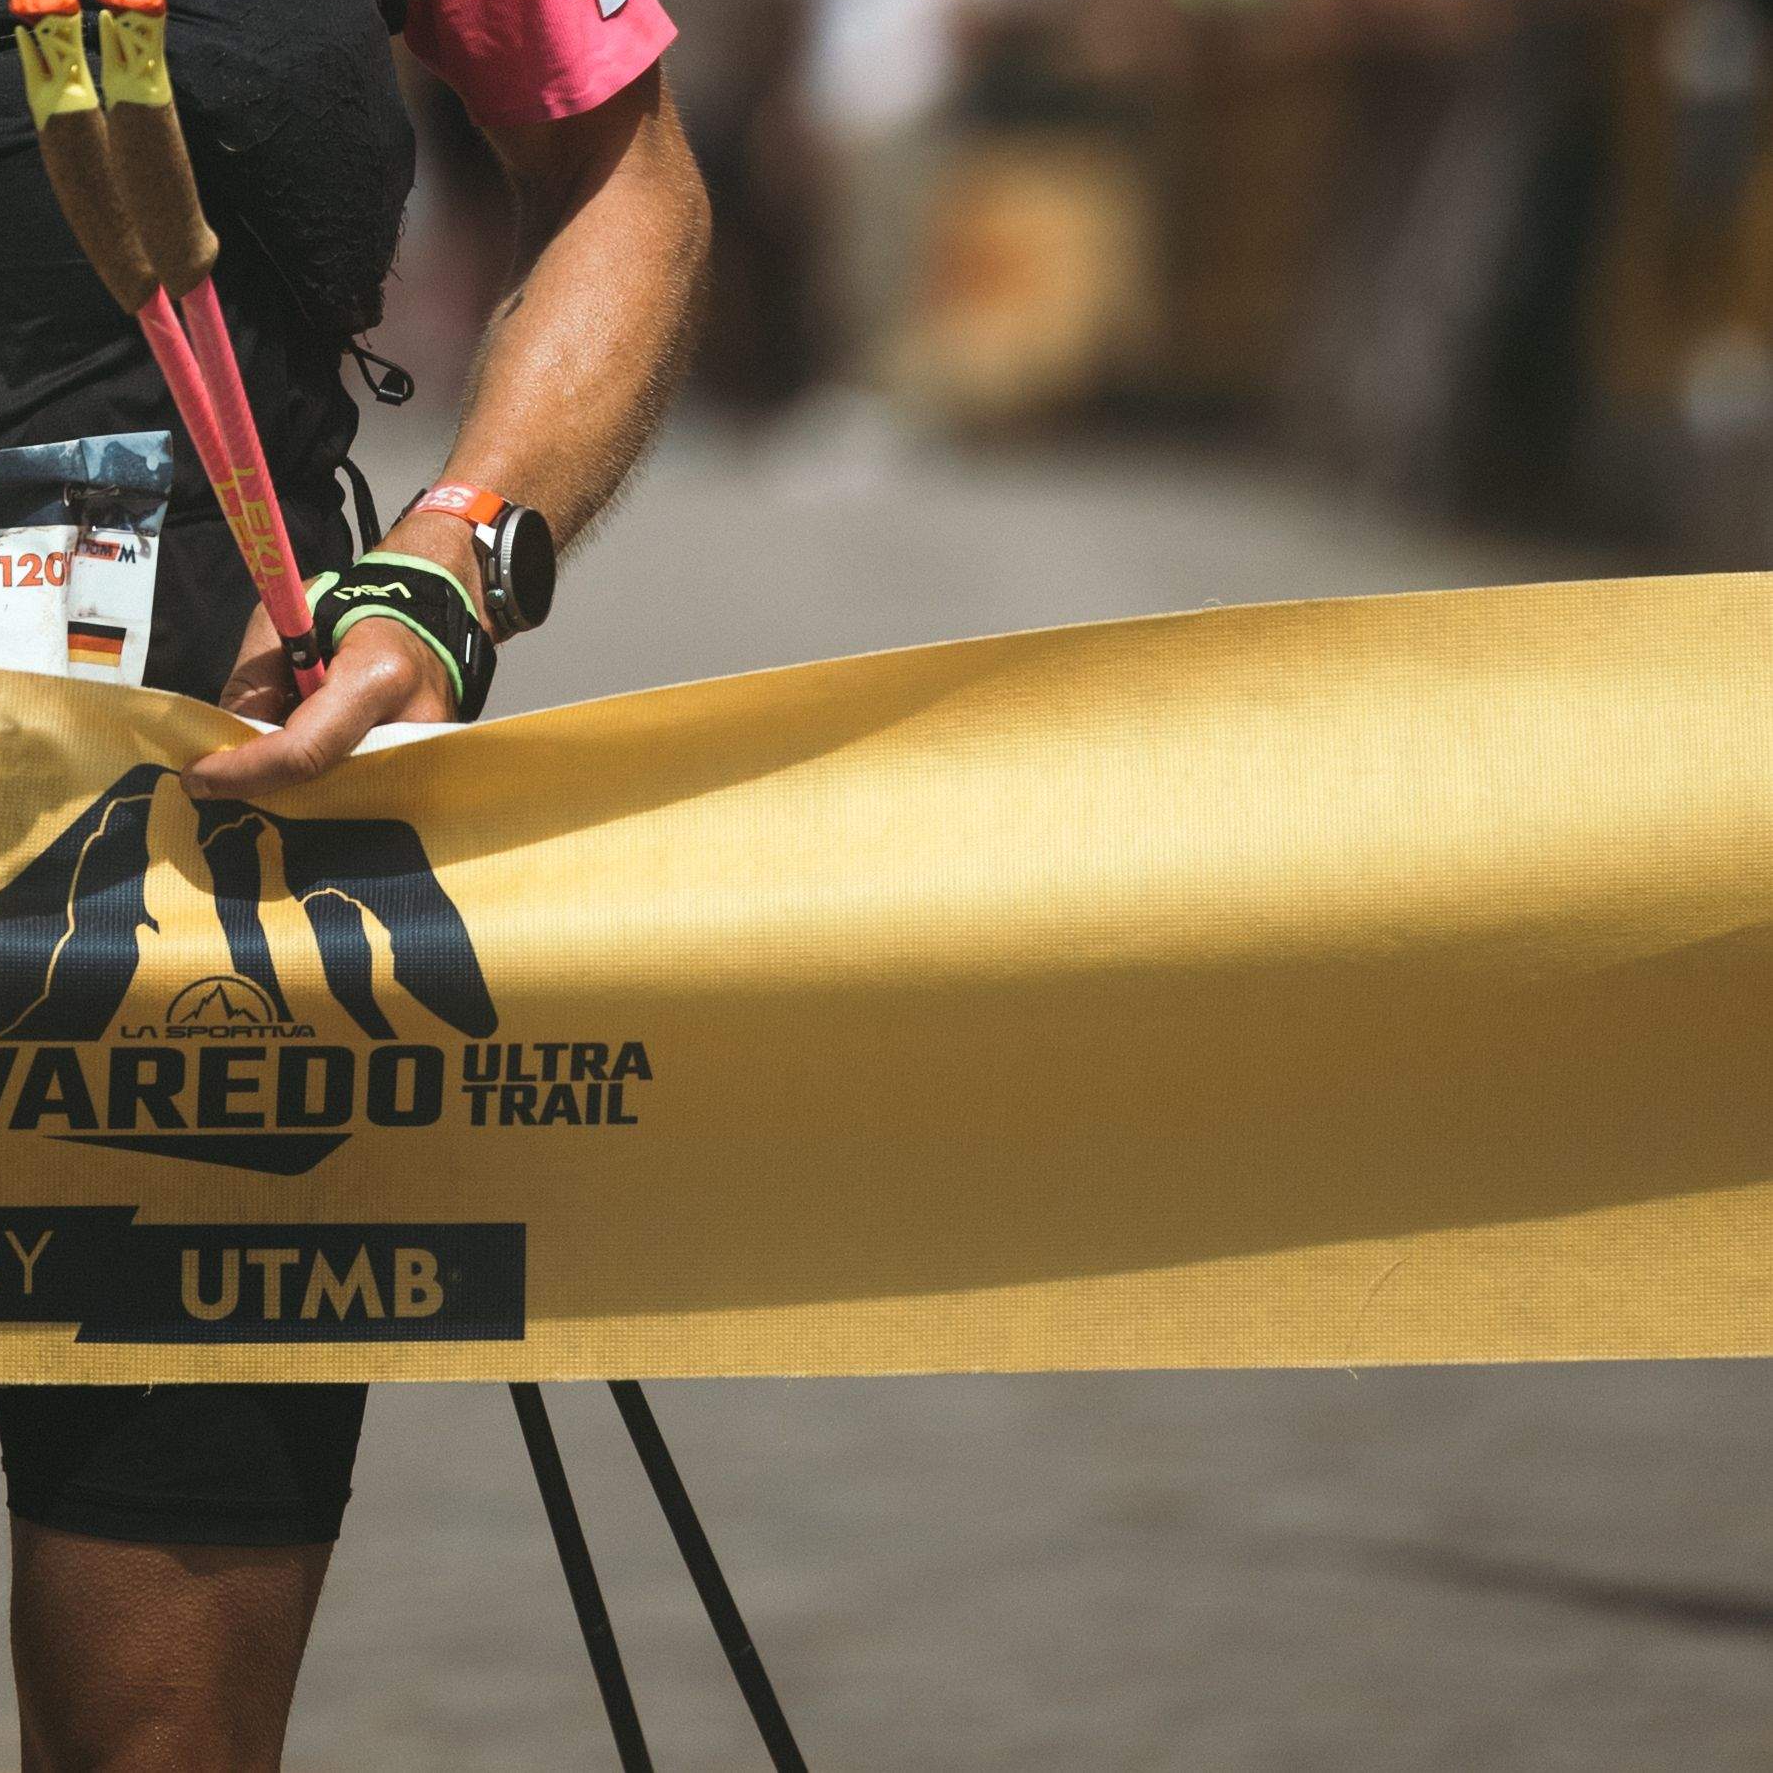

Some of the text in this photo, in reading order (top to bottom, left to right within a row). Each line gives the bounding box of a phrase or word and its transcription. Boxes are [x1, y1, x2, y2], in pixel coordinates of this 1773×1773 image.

[120, 1025, 316, 1040] LA SPORTIVA
[462, 1040, 654, 1084] ULTRA
[461, 1083, 639, 1126] TRAIL
[180, 1242, 445, 1321] UTMB
